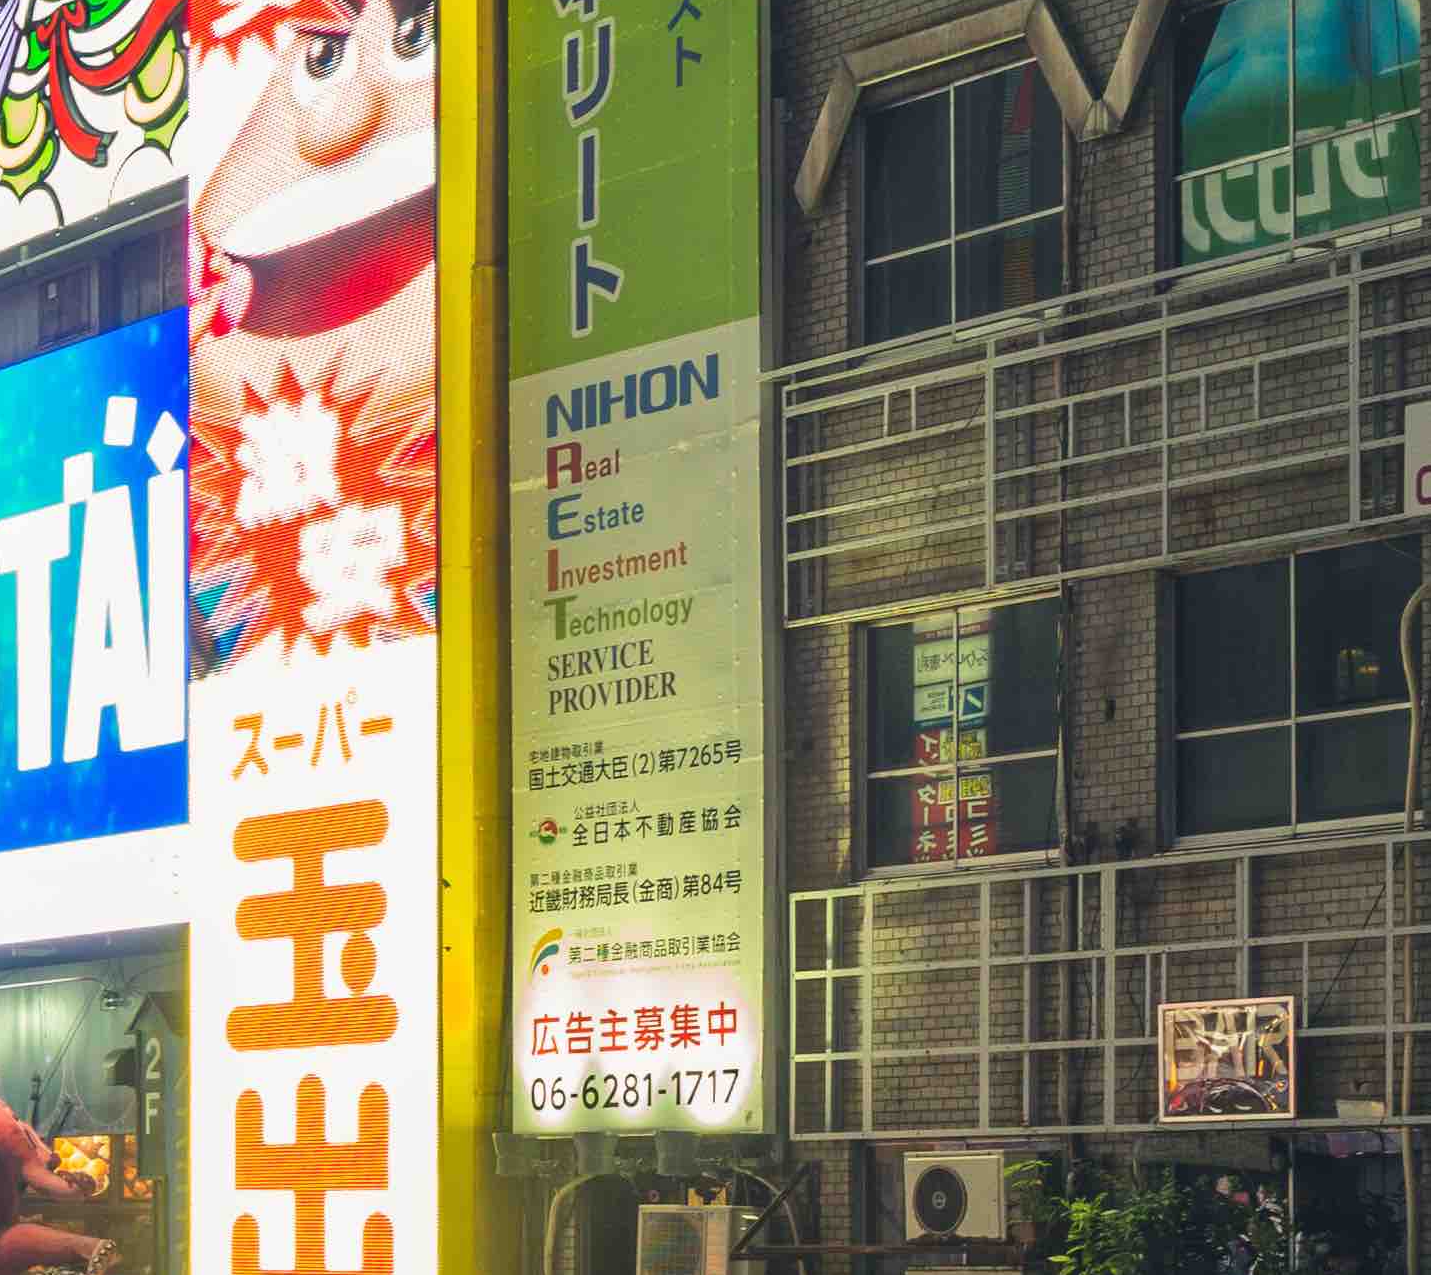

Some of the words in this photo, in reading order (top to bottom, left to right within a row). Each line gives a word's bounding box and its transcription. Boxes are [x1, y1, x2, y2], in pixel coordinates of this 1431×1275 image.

[546, 353, 720, 439] NIHON
[546, 442, 621, 490] Real
[548, 493, 645, 539] Estate
[546, 540, 689, 593] Investment
[544, 593, 695, 643] Technology
[547, 638, 655, 683] SERVICE
[547, 669, 678, 716] PROVIDER
[231, 686, 395, 781] スーパー
[529, 739, 742, 792] 国土交通大臣(2)第7265号
[572, 804, 742, 848] 全日本不動産協会
[529, 869, 743, 915] 近畿財務局長(金商)第84号
[530, 998, 740, 1059] 広告主募集中
[530, 1067, 741, 1115] 06-6281-1717
